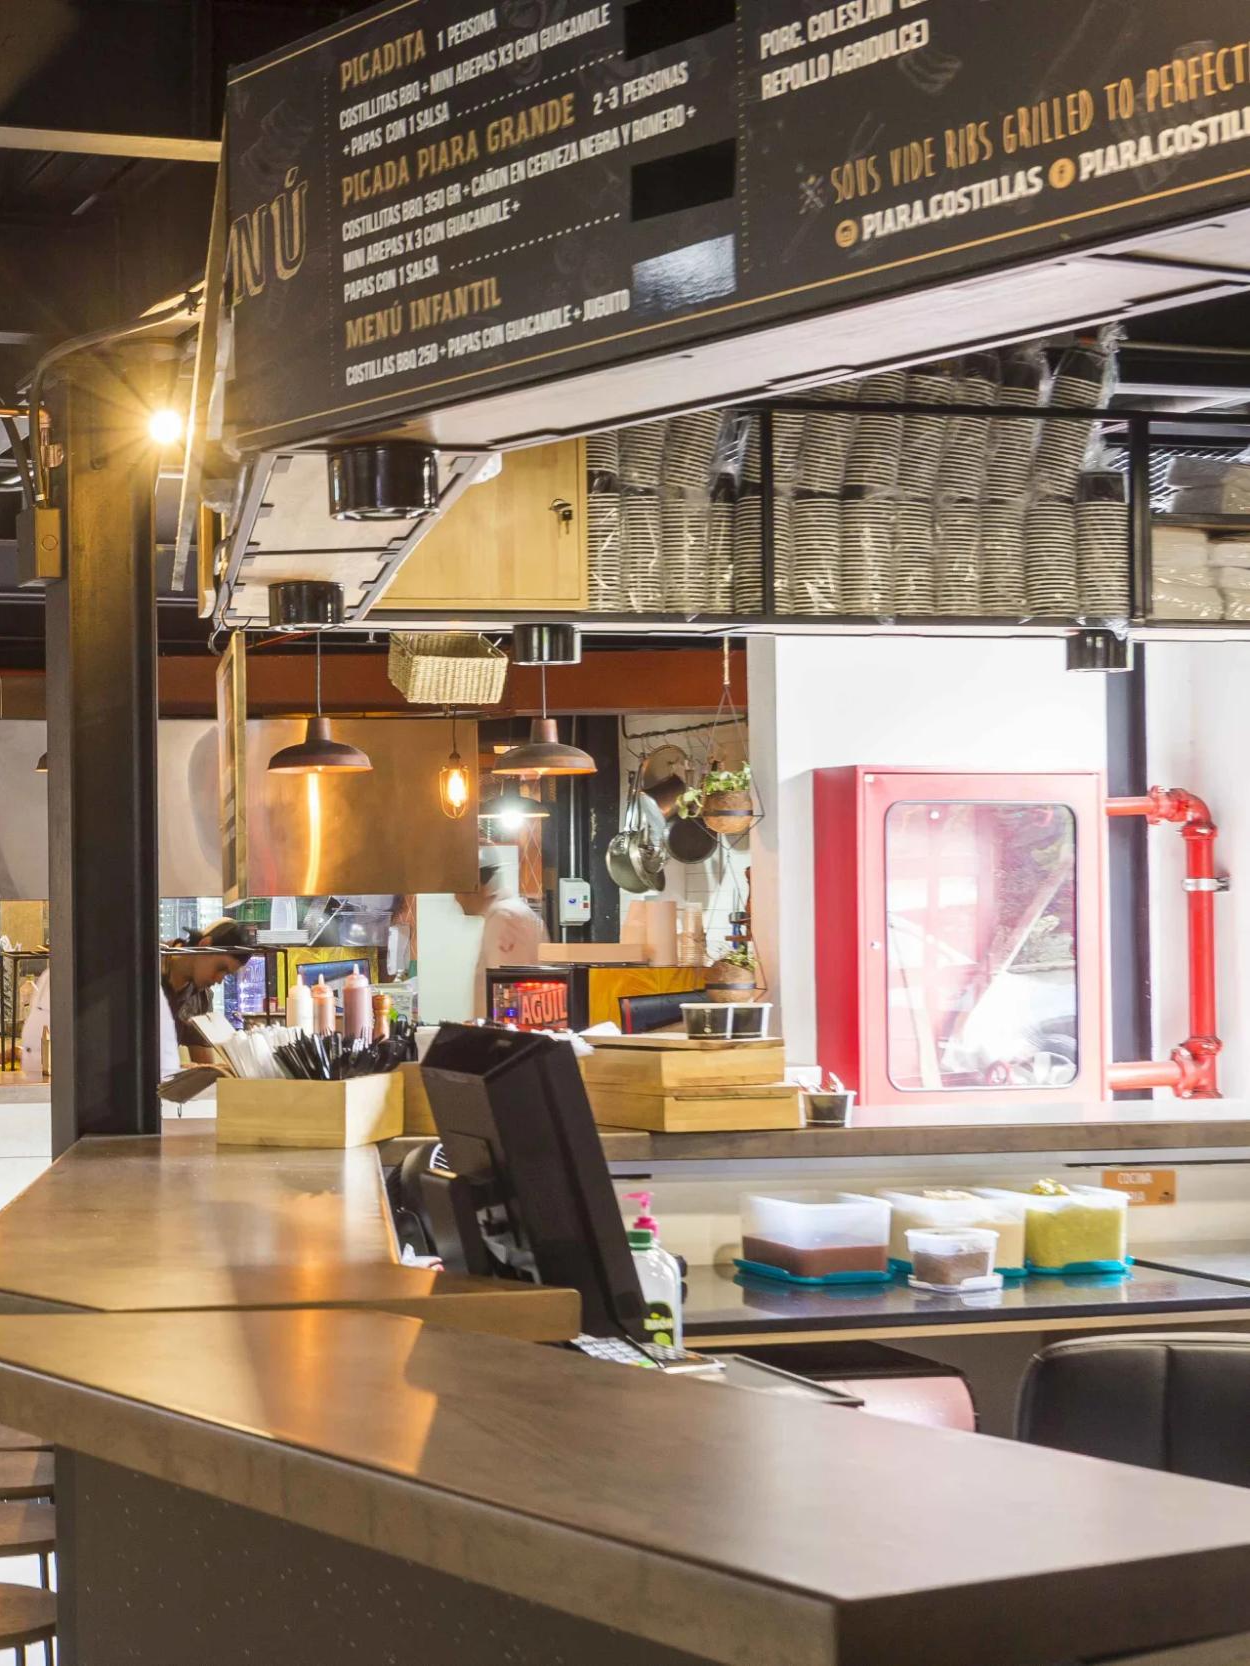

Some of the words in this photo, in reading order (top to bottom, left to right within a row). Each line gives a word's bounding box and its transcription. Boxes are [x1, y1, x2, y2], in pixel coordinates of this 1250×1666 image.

[339, 90, 399, 130] COSTILLITAS
[399, 81, 421, 107] BBQ
[430, 66, 454, 95] MINI
[455, 50, 497, 85] AREPAS
[497, 42, 514, 68] X3
[515, 32, 539, 61] CON
[540, 2, 611, 51] GUACAMOLE
[340, 29, 427, 92] PICADITA
[437, 30, 444, 52] 1
[447, 8, 497, 47] PERSONA
[761, 53, 830, 100] REPOLLO
[341, 155, 410, 208] PICADA
[417, 130, 479, 181] PIARA
[486, 92, 576, 155] GRANDE
[593, 86, 620, 116] 2-3
[622, 61, 689, 105] PERSONAS
[351, 127, 382, 157] PAPAS
[386, 117, 407, 144] CON
[408, 115, 415, 135] 1
[416, 101, 450, 132] SALSA
[830, 155, 882, 204] SOUS
[889, 137, 936, 187] VIDE
[944, 120, 994, 169] RIBS
[1002, 89, 1095, 154] GRILLED
[1103, 77, 1135, 121] TO
[1146, 41, 1250, 113] PERFECT
[342, 203, 401, 242] COSTILLITAS
[401, 196, 424, 222] BBQ
[446, 183, 462, 206] GR
[510, 160, 526, 184] EN
[526, 142, 579, 178] CERVEZA
[579, 126, 621, 161] NEGRA
[621, 122, 632, 146] Y
[632, 104, 686, 143] ROMERO
[861, 165, 1044, 242] PIARA.COSTILLAS
[343, 247, 366, 273] MINI
[366, 234, 404, 266] AREPAS
[404, 232, 415, 252] X
[415, 228, 423, 249] 3
[423, 221, 446, 246] CON
[446, 198, 512, 239] GUACAMOLE
[344, 275, 375, 303] PAPAS
[375, 268, 397, 293] CON
[398, 266, 405, 286] 1
[406, 255, 440, 284] SALSA
[345, 300, 402, 350] MENÚ
[409, 276, 502, 333] INFANTIL
[346, 354, 395, 387] COSTILLAS
[396, 348, 417, 372] BBQ
[417, 343, 439, 366] 250
[447, 330, 481, 359] PAPAS
[482, 323, 505, 349] CON
[505, 305, 572, 342] GUACAMOLE
[522, 989, 567, 1024] AGUIL
